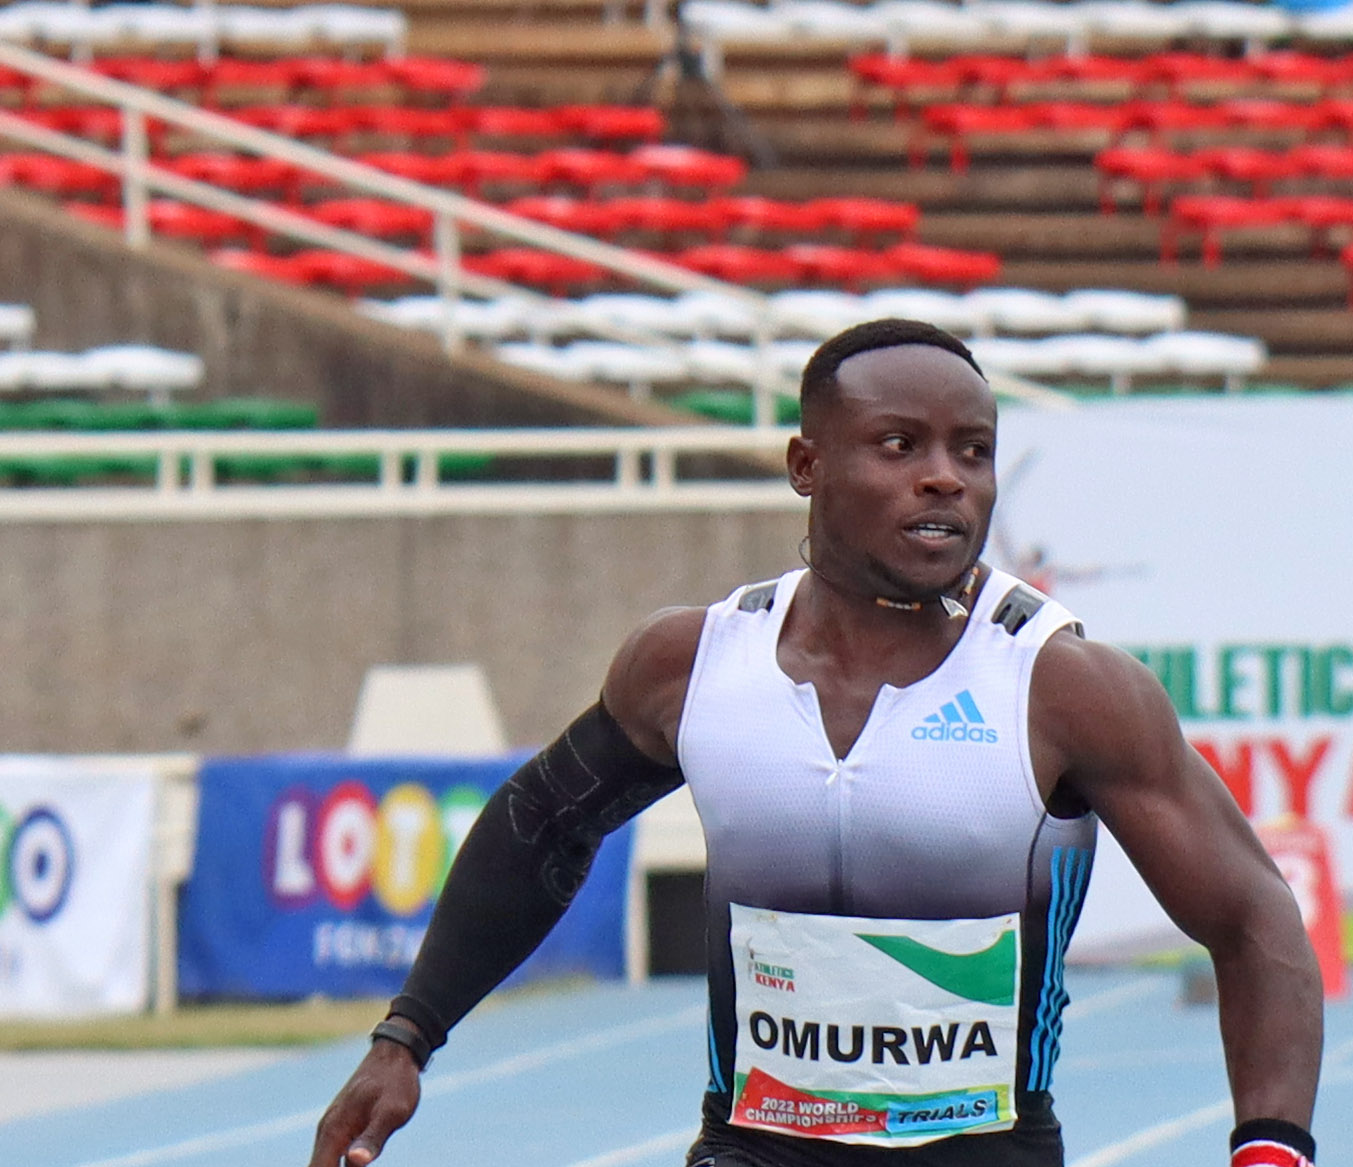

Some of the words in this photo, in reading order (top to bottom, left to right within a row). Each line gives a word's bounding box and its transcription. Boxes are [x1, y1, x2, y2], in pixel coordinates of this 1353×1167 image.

[911, 723, 998, 743] adidas
[754, 972, 795, 992] KENYA
[750, 1010, 998, 1066] OMURWA
[761, 1097, 795, 1112] 2022
[799, 1101, 859, 1115] WORLD
[898, 1099, 988, 1124] TRIALS
